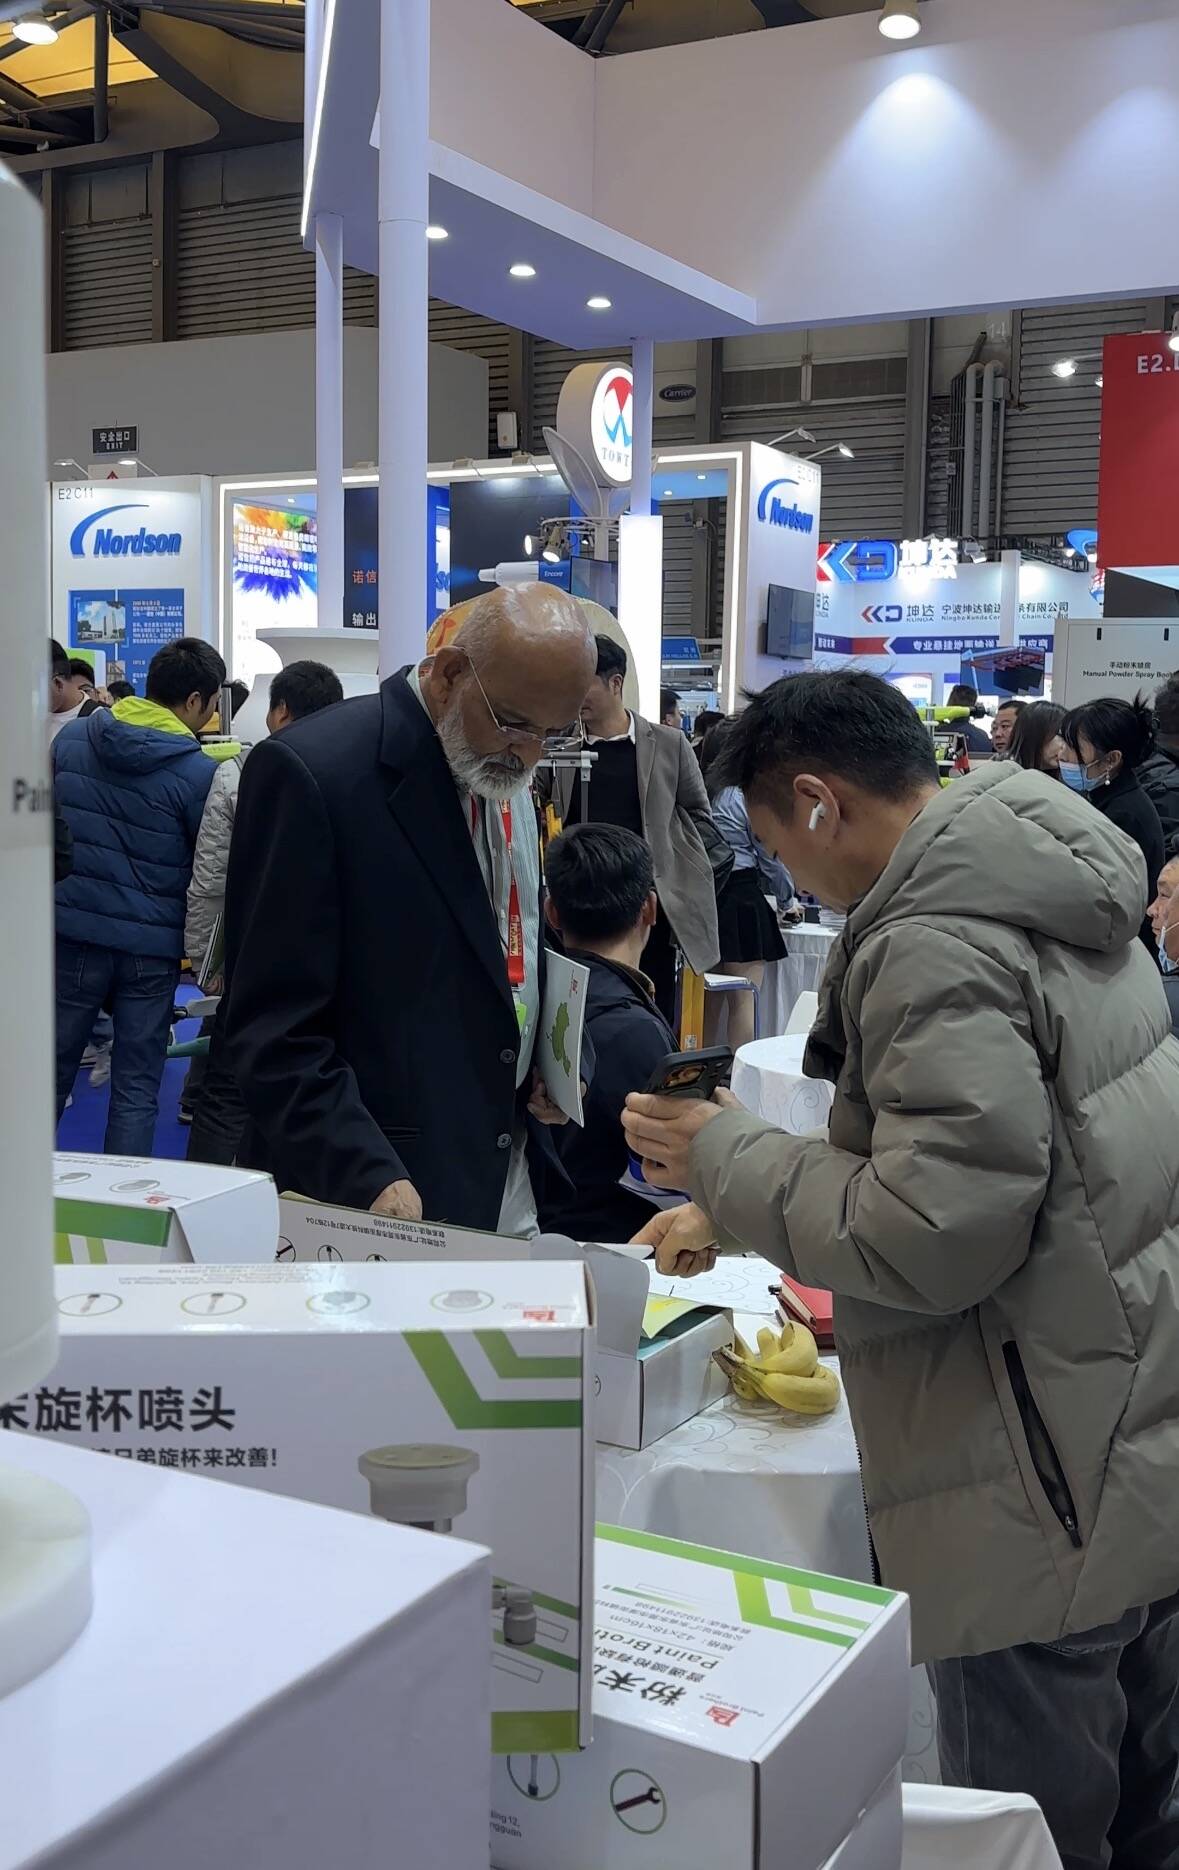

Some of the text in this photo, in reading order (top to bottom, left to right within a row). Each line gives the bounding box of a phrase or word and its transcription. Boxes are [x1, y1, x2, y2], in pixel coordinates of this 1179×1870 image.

[664, 388, 693, 399] Carrier
[100, 431, 130, 442] 安全出口
[106, 442, 123, 450] EXIT
[58, 487, 94, 500] E2 C11
[769, 497, 814, 534] Nordson
[93, 527, 182, 557] Nordson
[352, 570, 377, 584] 诺信
[906, 604, 934, 617] 坤达
[352, 612, 377, 626] 输出
[1135, 671, 1155, 679] Spray
[91, 1447, 278, 1468] 弟旋杯来改善!
[653, 1644, 720, 1671] Paint
